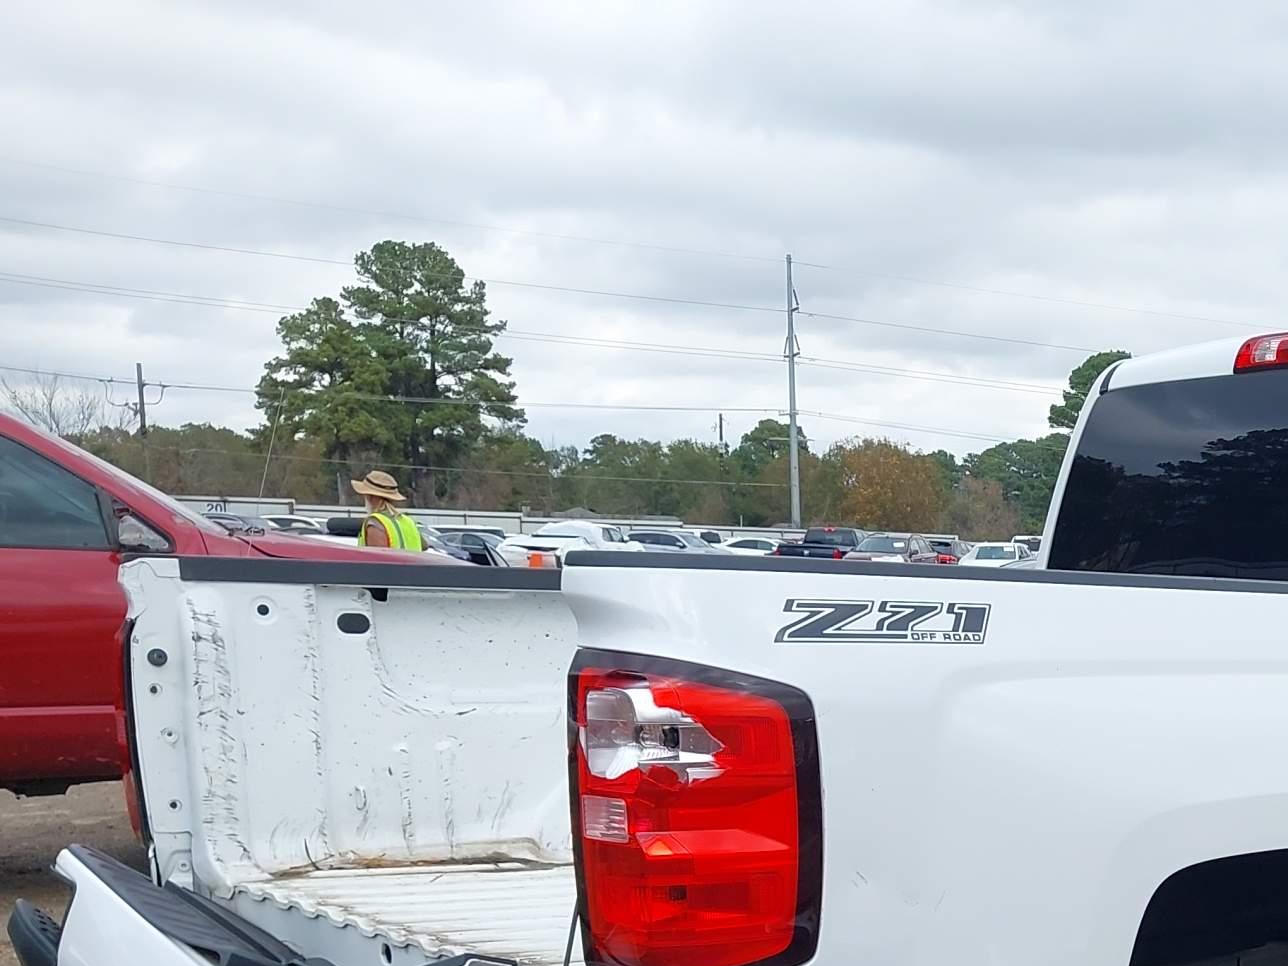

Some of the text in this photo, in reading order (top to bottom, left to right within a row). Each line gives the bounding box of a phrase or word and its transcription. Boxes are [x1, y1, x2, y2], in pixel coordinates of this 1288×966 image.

[774, 599, 991, 644] Z71
[911, 632, 982, 642] OFF ROAD
